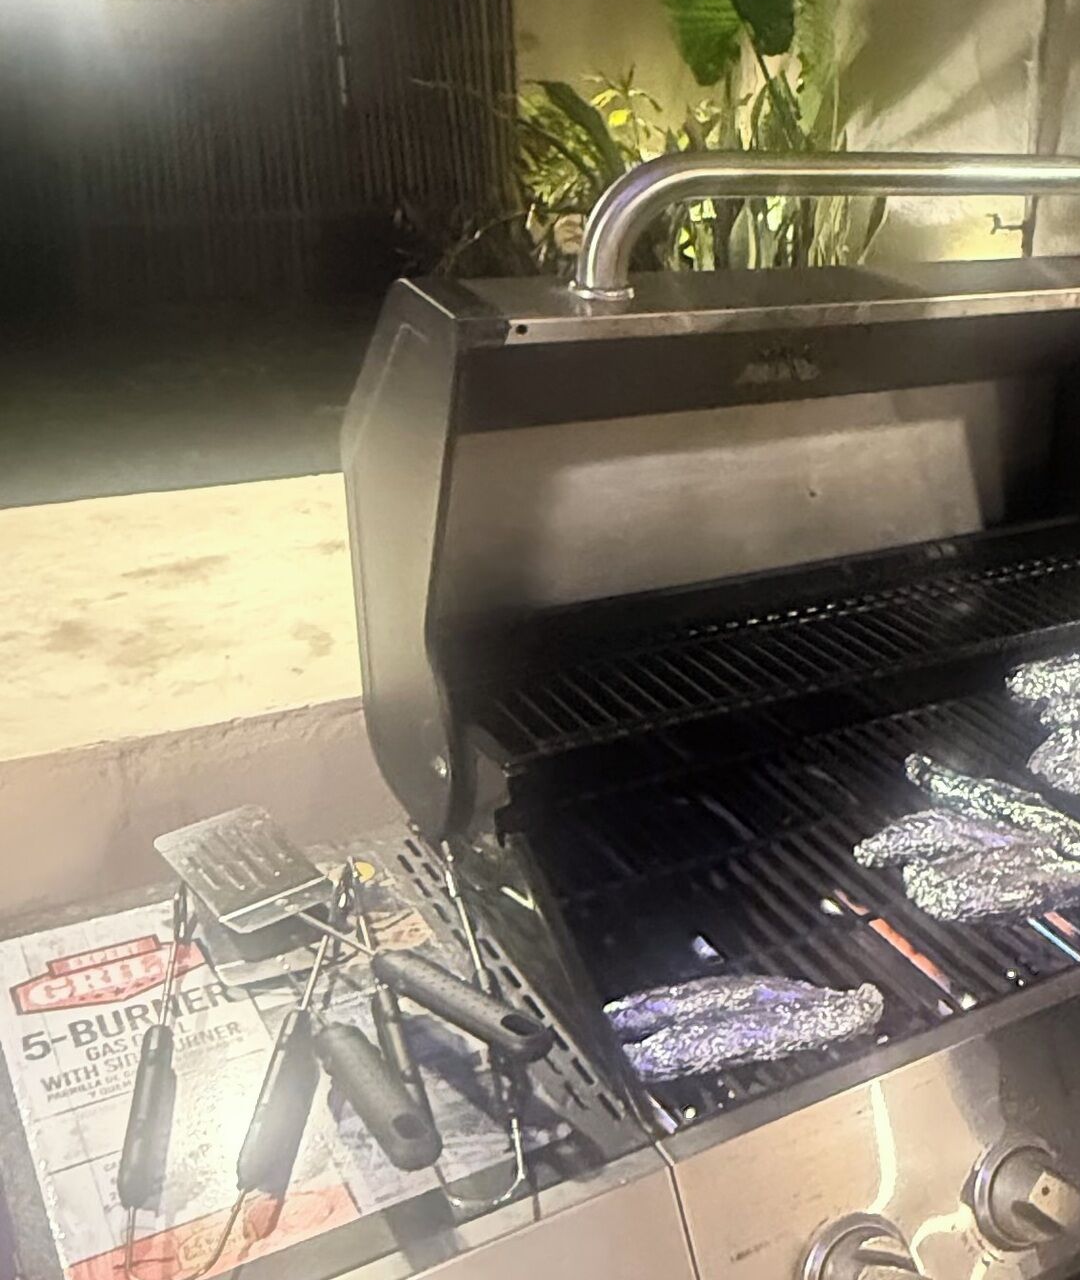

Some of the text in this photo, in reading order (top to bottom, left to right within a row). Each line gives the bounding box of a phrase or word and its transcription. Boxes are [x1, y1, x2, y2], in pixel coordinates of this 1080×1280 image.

[22, 982, 226, 1061] 5-BURNER
[41, 1063, 100, 1092] WITH
[104, 1052, 139, 1073] SID
[175, 1021, 242, 1052] URNER
[85, 1037, 129, 1061] GAS
